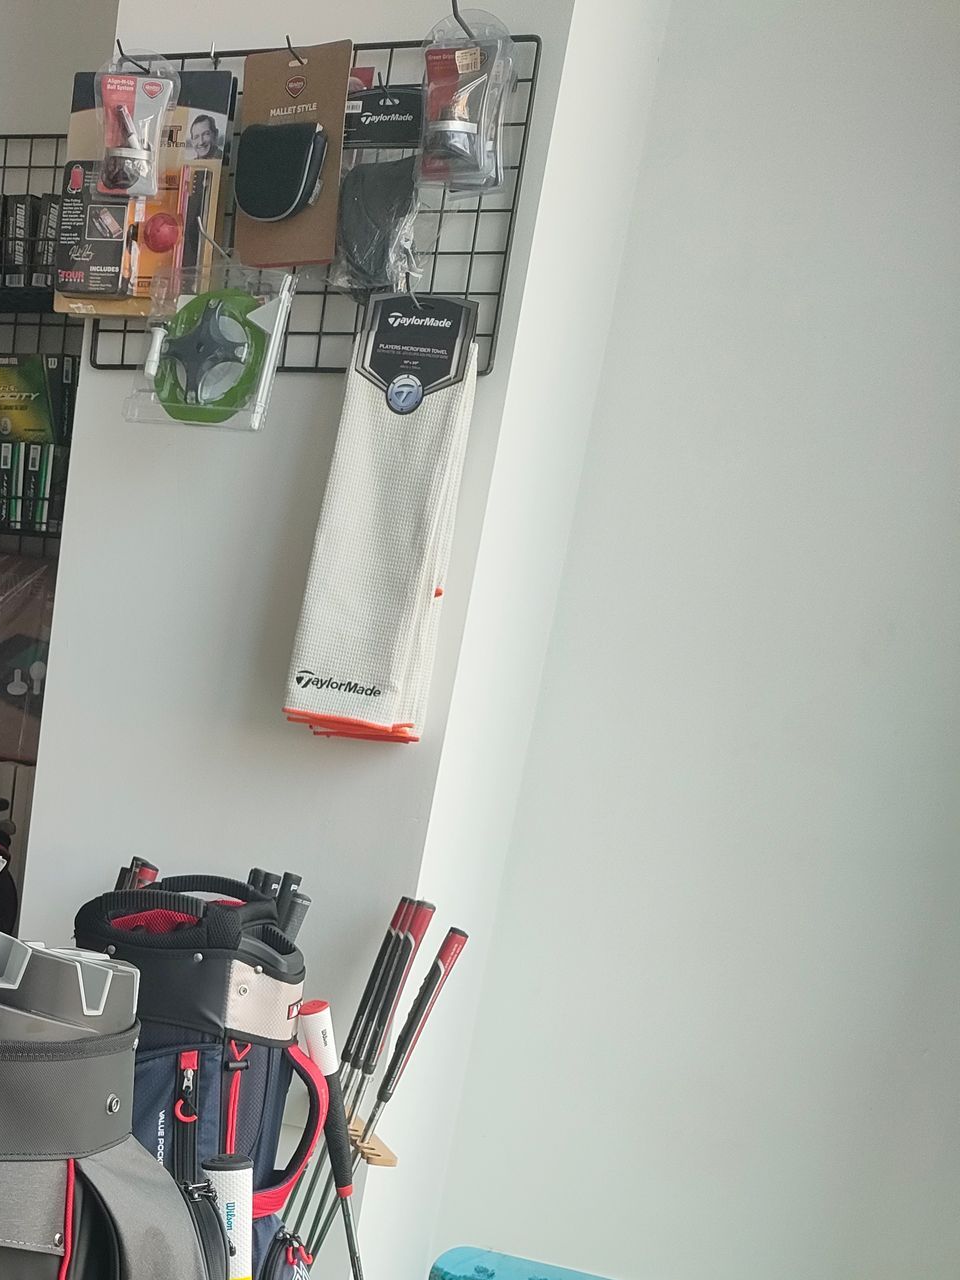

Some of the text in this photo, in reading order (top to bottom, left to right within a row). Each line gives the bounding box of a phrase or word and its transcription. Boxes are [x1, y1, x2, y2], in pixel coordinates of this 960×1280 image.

[270, 103, 317, 116] MALLET STYLE
[360, 112, 413, 125] TaylorMade
[89, 265, 119, 273] INCLUDES
[387, 312, 452, 328] TaylorMade
[295, 670, 382, 697] TaylorMade
[157, 1109, 166, 1137] VALUE
[226, 1202, 236, 1231] Wilson
